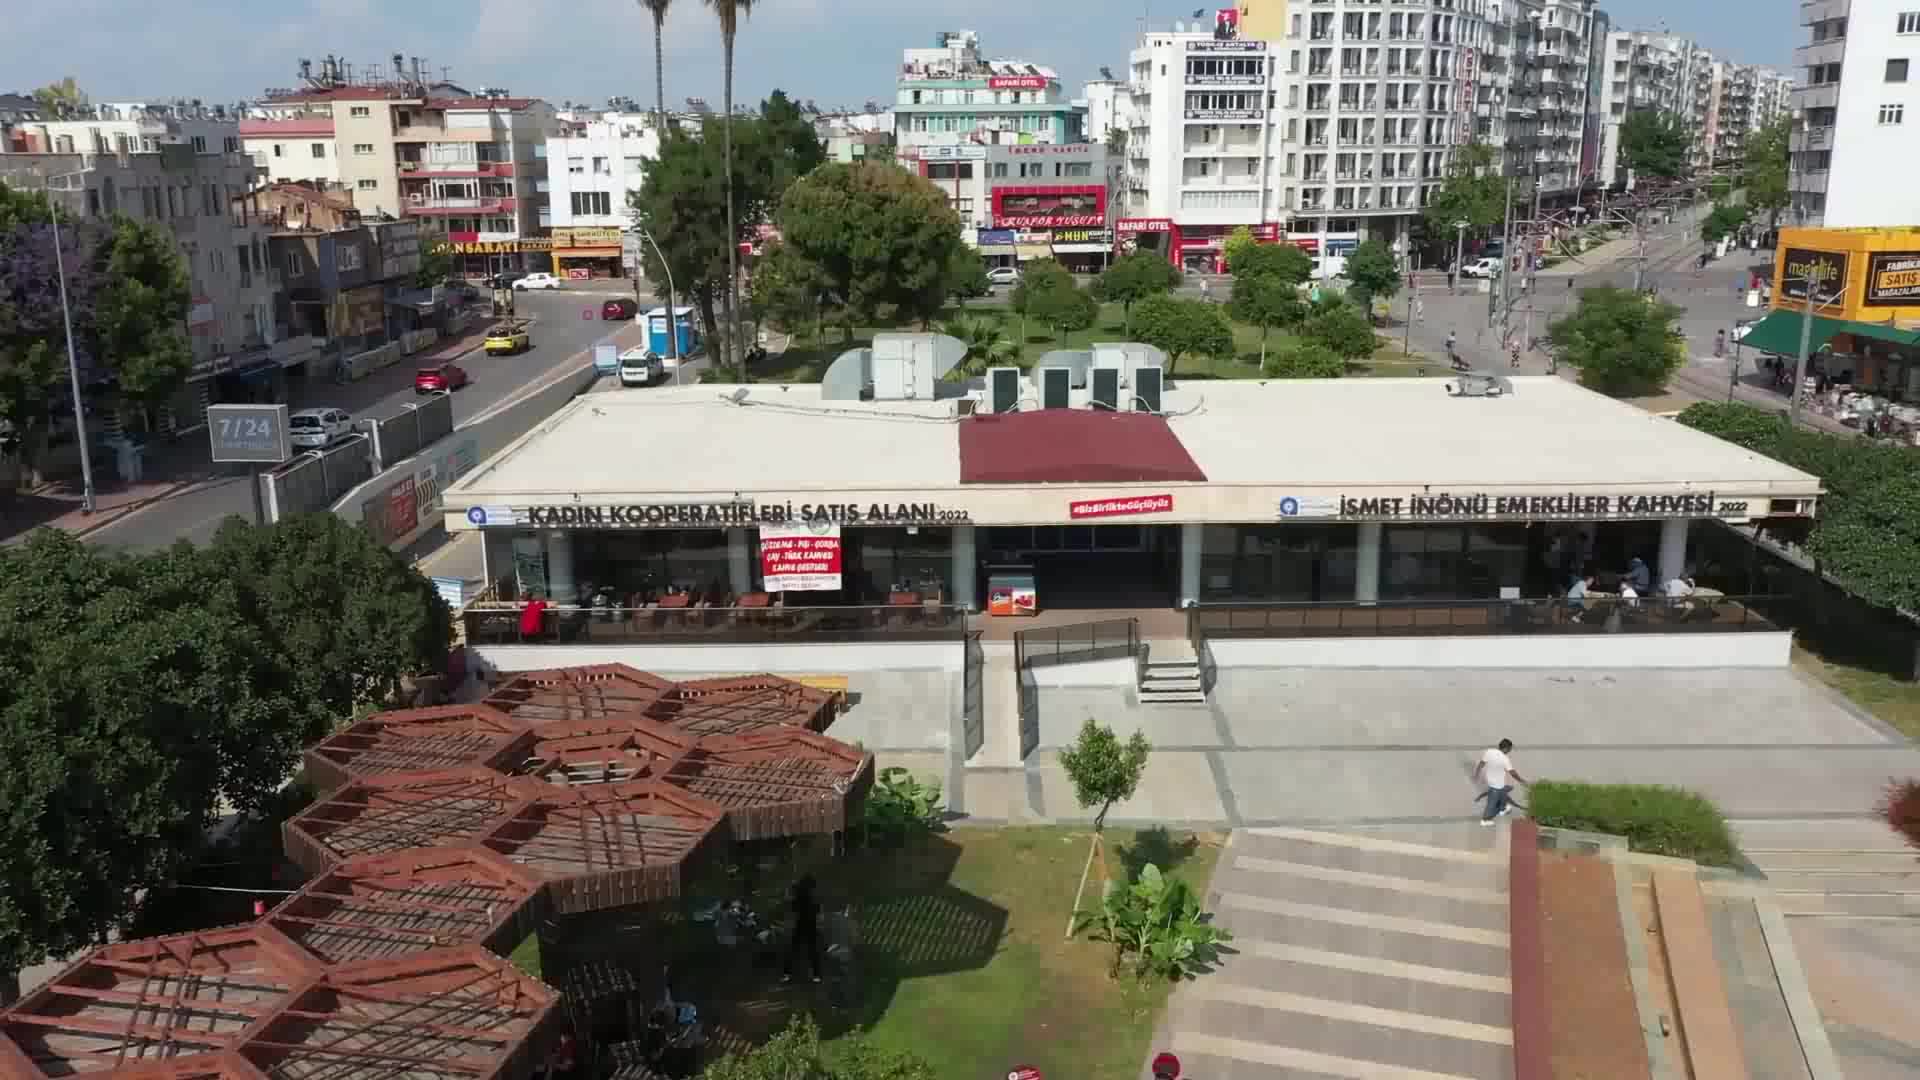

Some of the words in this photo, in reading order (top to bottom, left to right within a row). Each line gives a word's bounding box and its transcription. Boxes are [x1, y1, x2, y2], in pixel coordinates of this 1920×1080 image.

[995, 79, 1020, 87] SAFARİ
[1021, 79, 1040, 87] OTEL
[1118, 221, 1147, 231] SAFARİ
[1148, 221, 1170, 231] OTEL
[216, 419, 270, 439] 7/24
[528, 506, 601, 524] KADIN
[611, 501, 792, 523] KOOPERATİFLERİ
[801, 503, 859, 523] SATIŞ
[867, 503, 935, 521] ALANI
[939, 510, 969, 521] 2022
[1073, 497, 1169, 515] #BizBirlikteGüçlüyüz
[1340, 494, 1403, 516] İSMET
[1410, 493, 1488, 516] İNÖNÜ
[1496, 492, 1612, 514] EMEKLİLER
[1617, 490, 1715, 513] KAHVESİ
[1718, 501, 1748, 512] 2022
